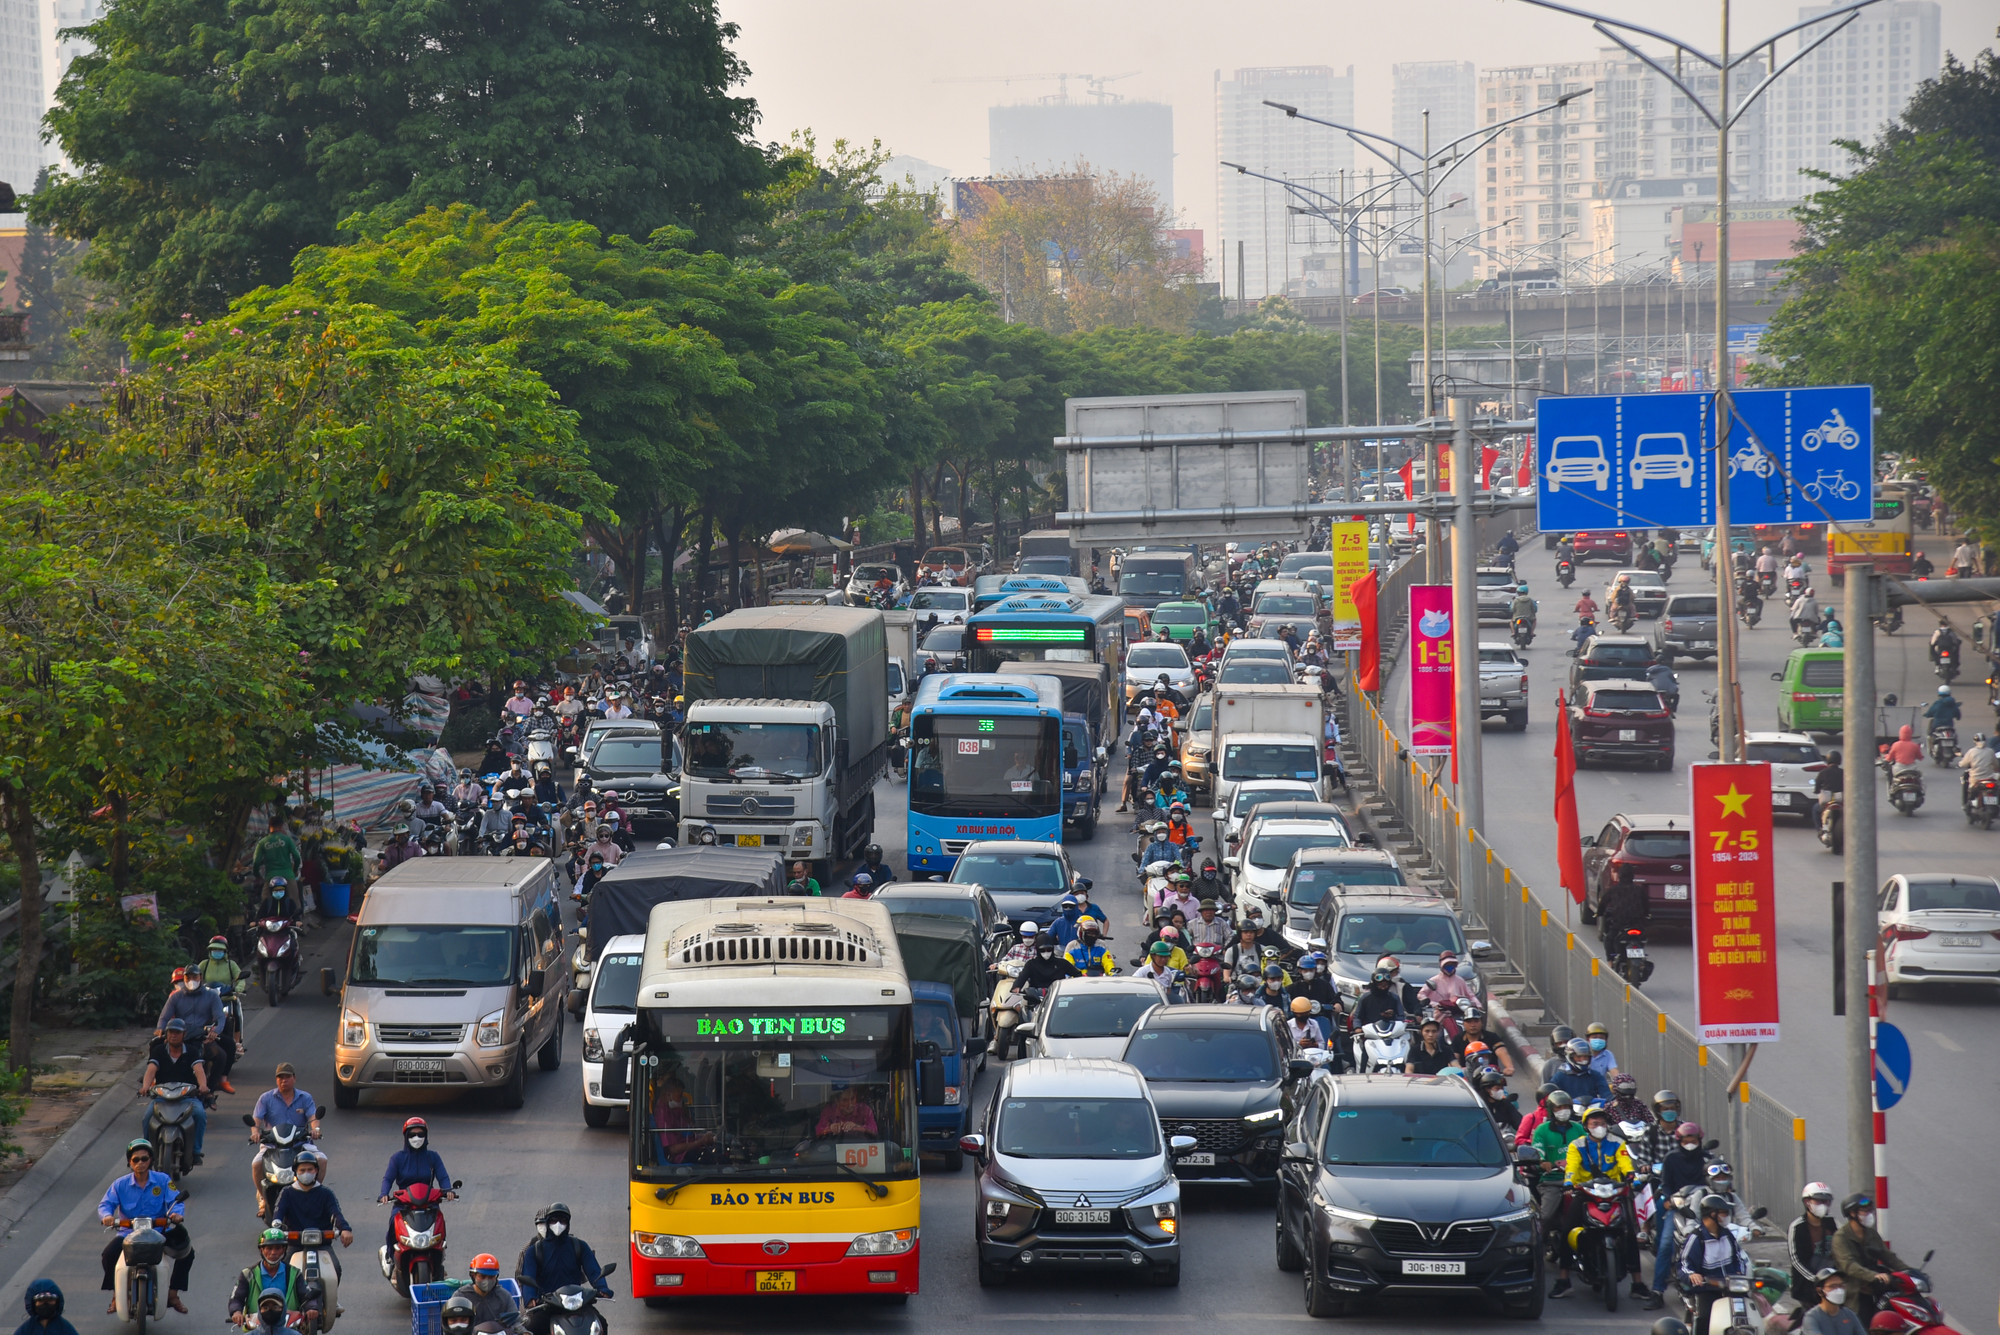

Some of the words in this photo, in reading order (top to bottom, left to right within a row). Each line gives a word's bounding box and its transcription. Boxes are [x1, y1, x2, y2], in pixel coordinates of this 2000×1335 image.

[1341, 534, 1361, 545] 7-5
[1418, 640, 1452, 664] 1-5
[959, 741, 979, 753] 03B
[969, 825, 984, 834] BUS
[987, 825, 997, 834] HÀ
[1710, 830, 1758, 851] 7-5
[1712, 852, 1732, 862] 1954
[1738, 852, 1759, 862] 2024
[697, 1018, 744, 1035] BAO
[749, 1018, 796, 1034] YEN
[800, 1017, 846, 1034] BUS
[1705, 1028, 1727, 1039] QUẬN
[1730, 1027, 1757, 1037] HOÀNG
[1759, 1028, 1776, 1036] MAI
[711, 1188, 749, 1206] BẢO
[755, 1187, 792, 1205] YẾN
[799, 1191, 835, 1204] BUS
[1056, 1211, 1109, 1223] 30G-315.45
[1408, 1263, 1460, 1273] 30G-189.73
[760, 1282, 791, 1291] 004.17
